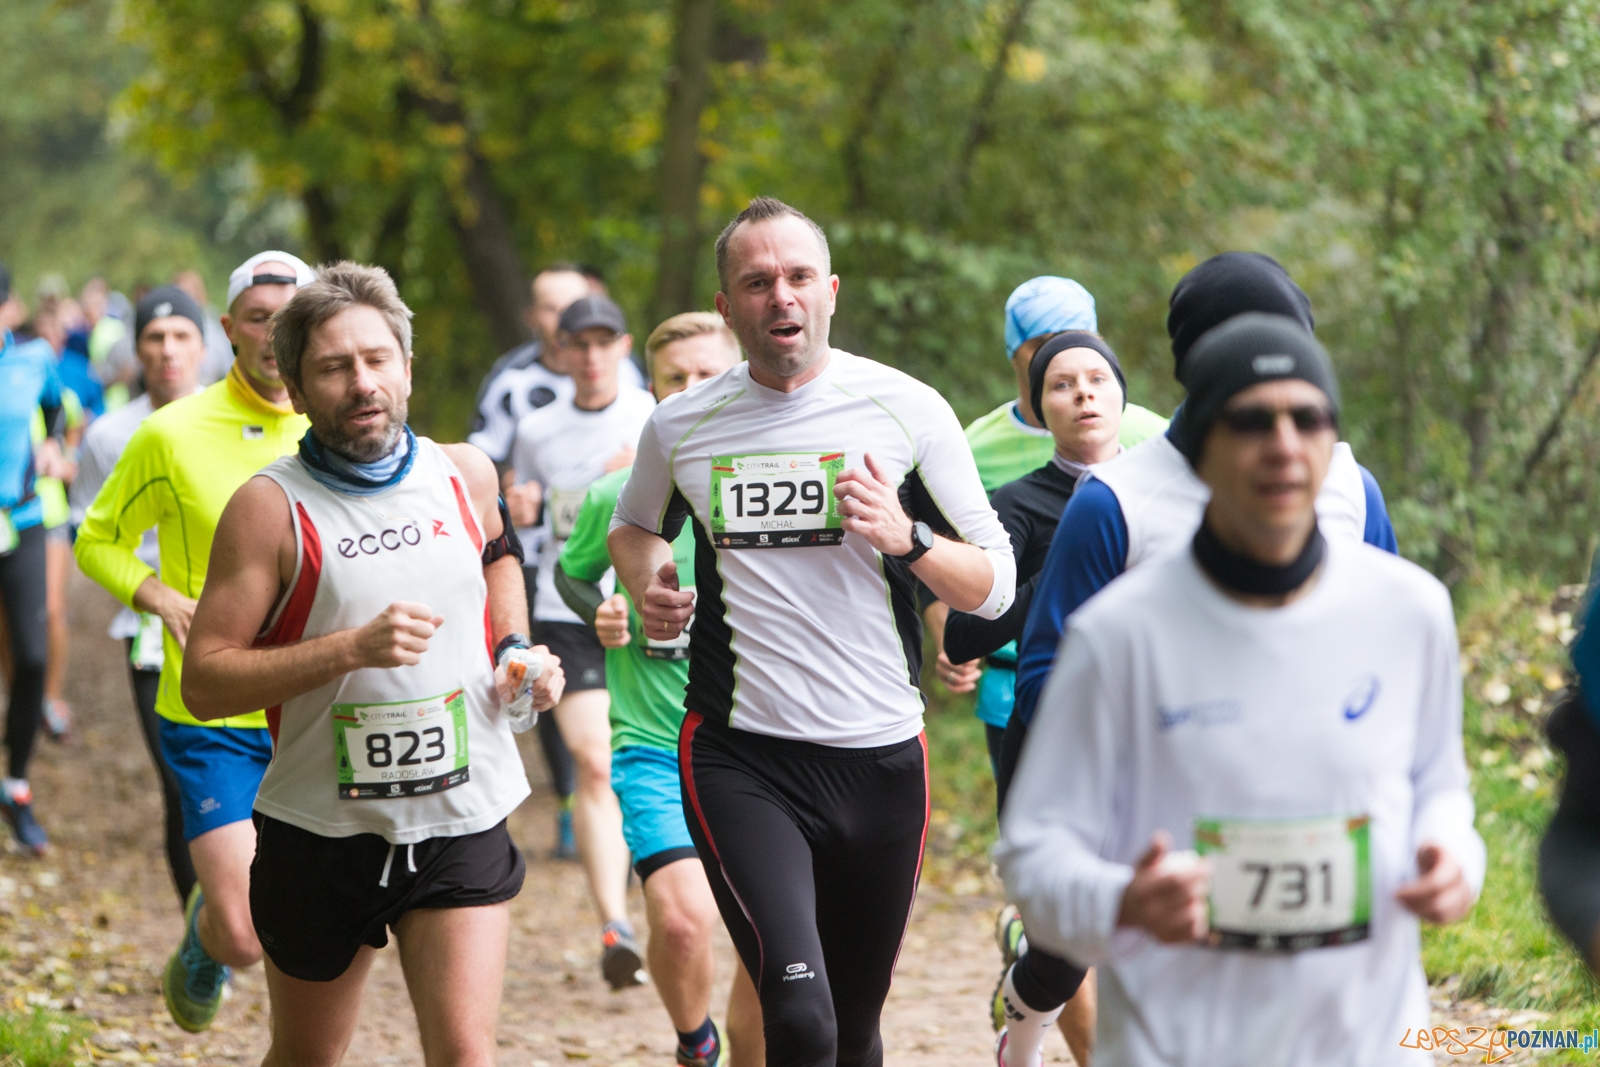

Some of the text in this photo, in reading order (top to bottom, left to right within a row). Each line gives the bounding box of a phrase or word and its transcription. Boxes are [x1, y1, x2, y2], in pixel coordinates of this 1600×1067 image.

[730, 480, 824, 517] 1329
[337, 524, 421, 559] ecco
[760, 520, 796, 530] MICHAŁ
[365, 726, 446, 769] 823
[381, 767, 436, 781] RADOSŁAW
[1241, 861, 1332, 911] 731
